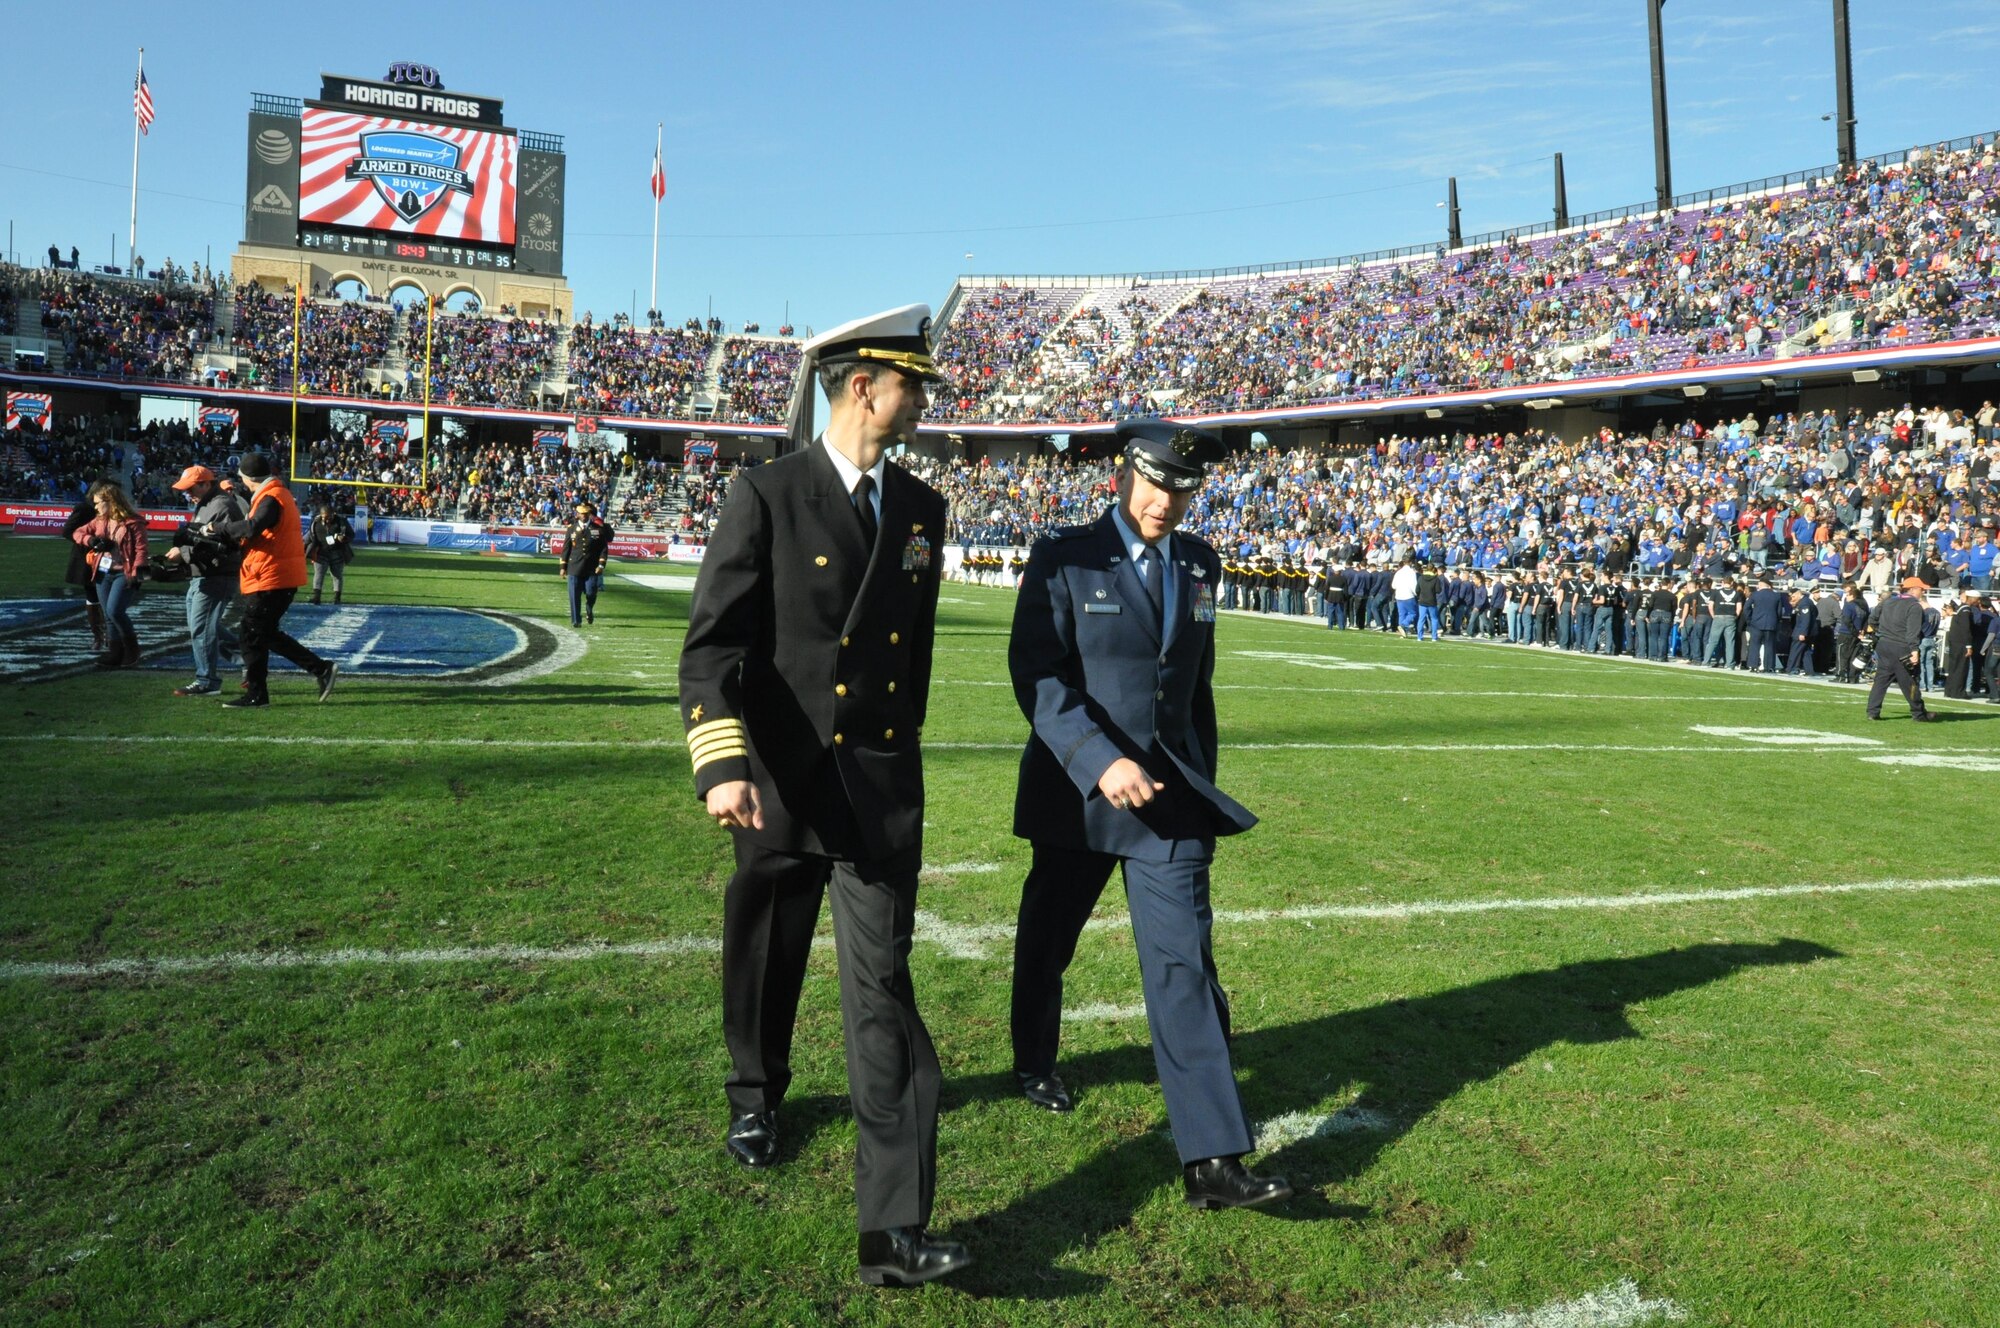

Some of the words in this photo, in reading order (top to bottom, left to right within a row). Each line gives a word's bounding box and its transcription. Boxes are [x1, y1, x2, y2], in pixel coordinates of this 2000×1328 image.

[390, 62, 440, 88] TCU
[345, 84, 418, 110] HORNED
[421, 94, 480, 118] FROGS
[371, 145, 405, 155] LOCKHEED
[406, 150, 434, 158] MARTIN
[358, 160, 407, 174] ARMED
[410, 163, 463, 184] FORCES
[392, 178, 429, 190] BOWL
[251, 204, 293, 215] Albertsons
[304, 234, 320, 246] 21
[323, 234, 334, 244] AF
[520, 235, 559, 252] Frost
[343, 242, 349, 252] 2
[397, 244, 426, 258] 13:43
[454, 254, 460, 264] 3
[467, 256, 474, 266] 0
[477, 252, 492, 262] CAL
[496, 255, 510, 268] 35
[362, 262, 387, 271] DAVE
[401, 266, 442, 278] BLOXOM,
[445, 271, 460, 279] SR.
[577, 416, 597, 433] 25
[6, 508, 37, 518] Serving
[38, 509, 63, 517] active
[16, 518, 46, 527] Armed
[626, 536, 652, 544] veterans
